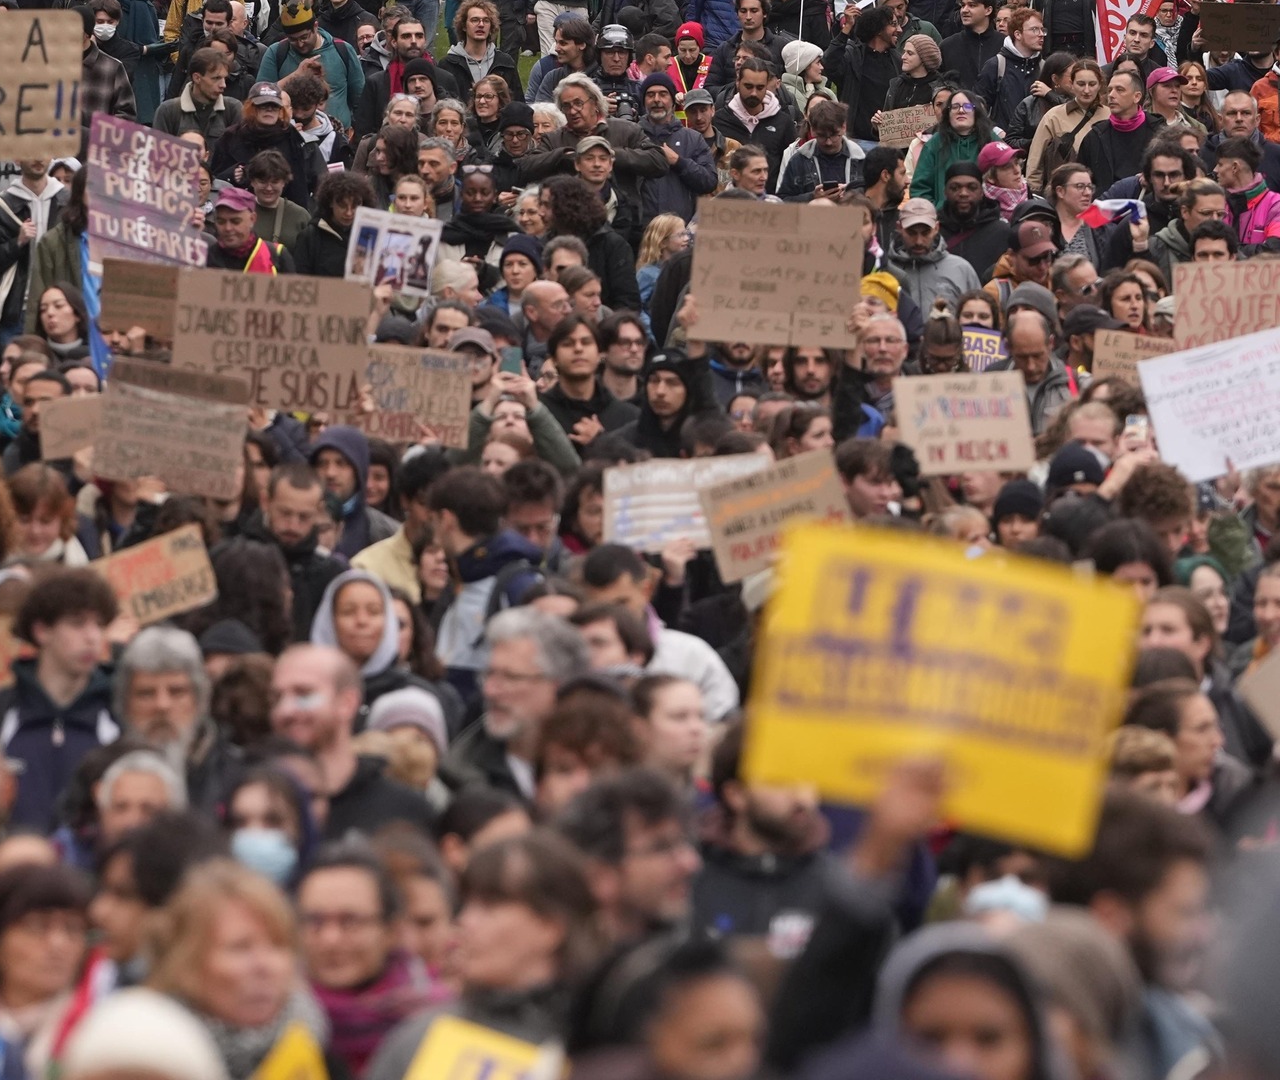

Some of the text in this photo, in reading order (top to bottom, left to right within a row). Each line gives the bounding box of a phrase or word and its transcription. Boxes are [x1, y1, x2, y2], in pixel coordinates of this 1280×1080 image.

[21, 17, 48, 64] A
[96, 120, 200, 175] TU CASSES
[88, 143, 195, 199] LE SERVICE
[88, 209, 209, 267] TU RÉPARES
[775, 238, 810, 255] QUI
[221, 276, 319, 307] MOI AUSSI
[1175, 264, 1222, 294] PAS
[244, 307, 285, 340] PEUR
[290, 311, 312, 342] DE
[319, 313, 368, 346] VENIR
[1103, 331, 1121, 348] LE
[256, 341, 296, 368] POUR
[280, 369, 328, 410] SUIS
